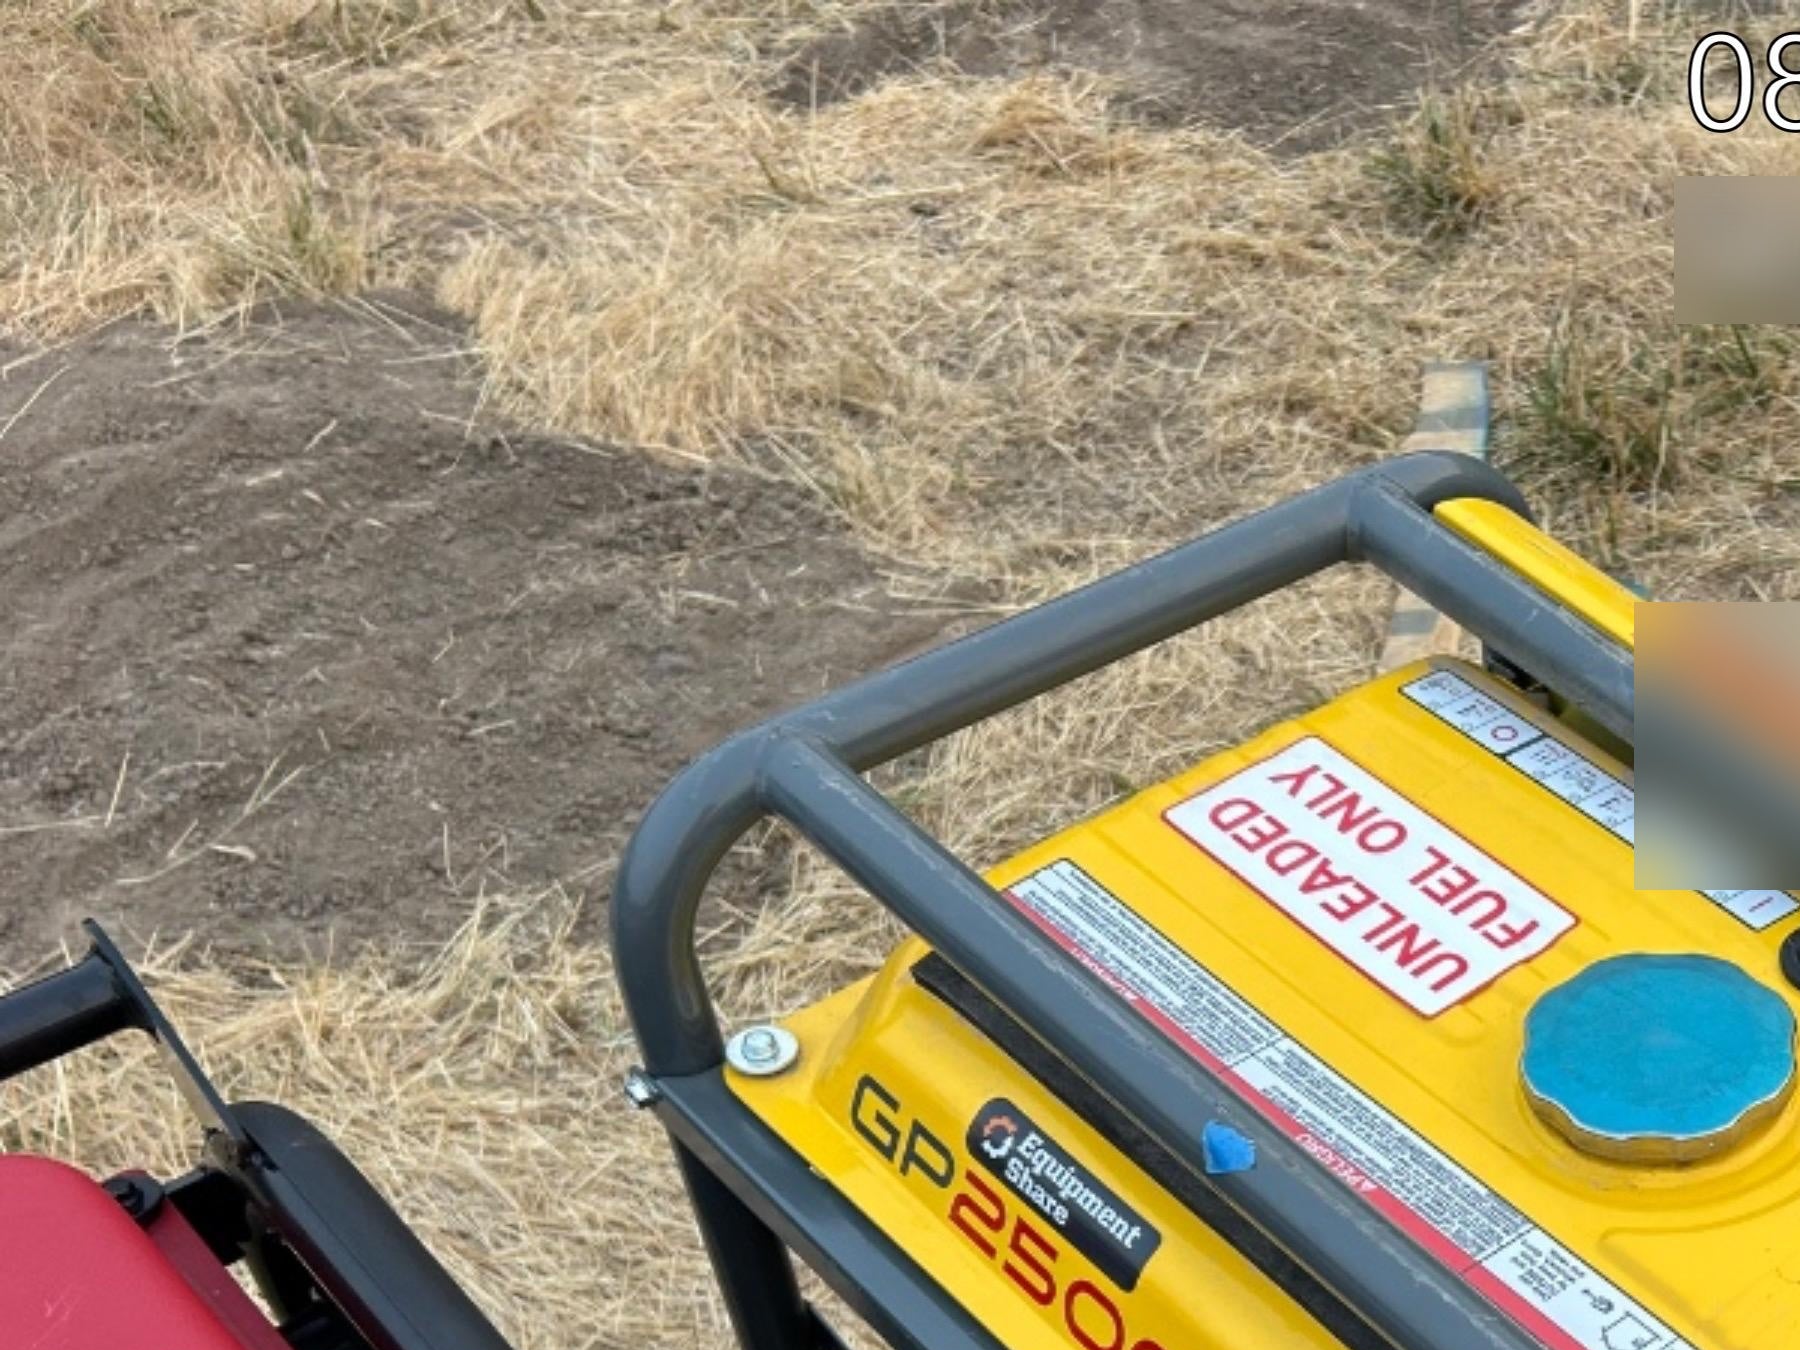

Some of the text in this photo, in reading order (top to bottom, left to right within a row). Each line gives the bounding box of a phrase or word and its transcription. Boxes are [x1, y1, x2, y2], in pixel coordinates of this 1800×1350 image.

[1268, 764, 1408, 855] ONLY
[1208, 797, 1471, 993] UNLEADED
[1408, 845, 1540, 950] FUEL
[1003, 1156, 1070, 1227] Share
[1016, 1130, 1142, 1249] Equipment
